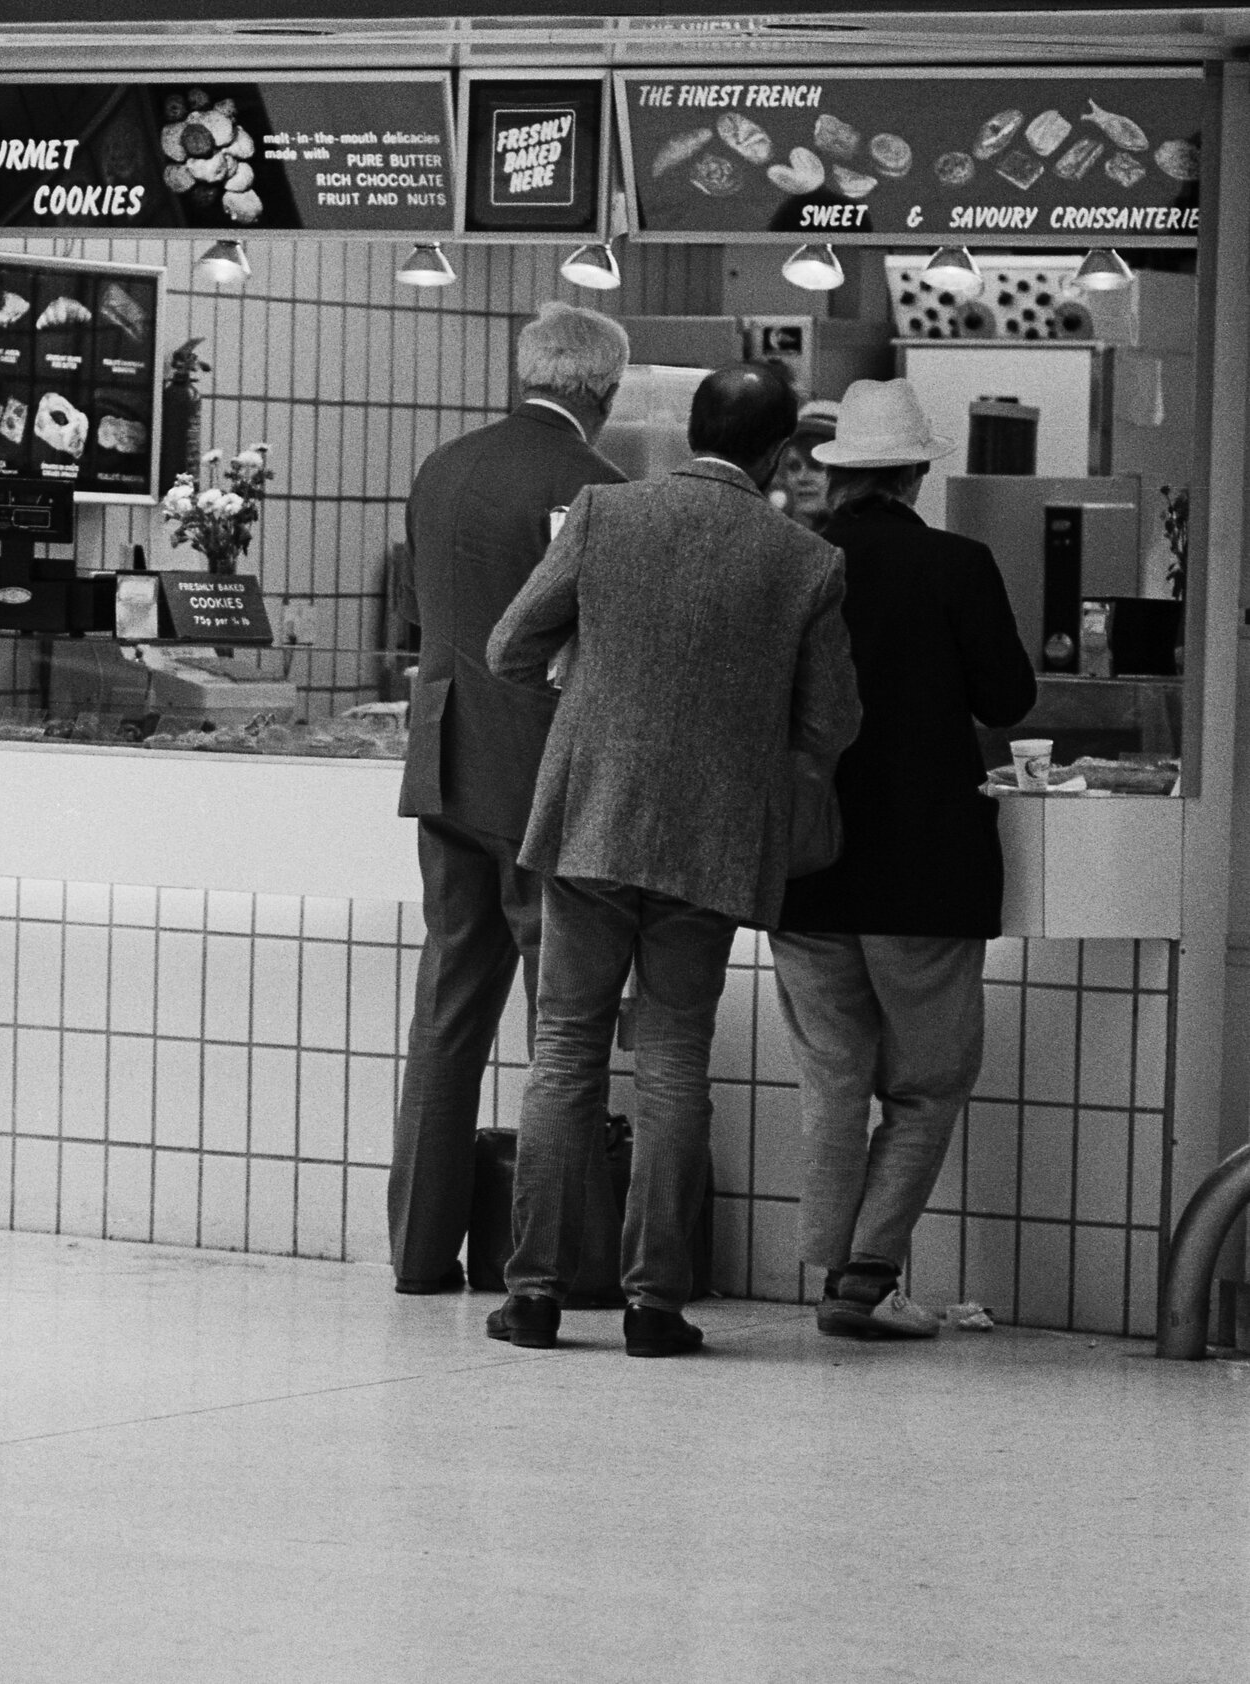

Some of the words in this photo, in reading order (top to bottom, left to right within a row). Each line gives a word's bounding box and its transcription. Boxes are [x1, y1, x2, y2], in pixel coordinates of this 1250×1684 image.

[639, 85, 674, 106] THE
[677, 85, 744, 107] FINEST
[745, 85, 822, 107] FRENCH
[263, 131, 378, 144] melt-in-the-mouth
[382, 131, 440, 145] delicacies
[497, 114, 572, 153] FRESHLY
[264, 148, 297, 161] made
[303, 148, 330, 160] with
[347, 154, 384, 168] PURE
[390, 154, 442, 168] BUTTER
[504, 140, 562, 173] BAKED
[316, 173, 351, 186] RICH
[356, 172, 443, 187] CHOCOLATE
[509, 163, 555, 194] HERE
[33, 184, 145, 216] COOKIES
[318, 192, 359, 206] FRUIT
[367, 192, 398, 206] AND
[407, 193, 447, 207] NUTS
[800, 205, 868, 227] SWEET
[907, 205, 923, 228] &
[950, 206, 1039, 229] SAVOURY
[1050, 206, 1199, 230] CROISSANTERIE
[178, 582, 214, 592] FRESHLY
[217, 583, 245, 592] BAKED
[189, 596, 244, 609] COOKIES
